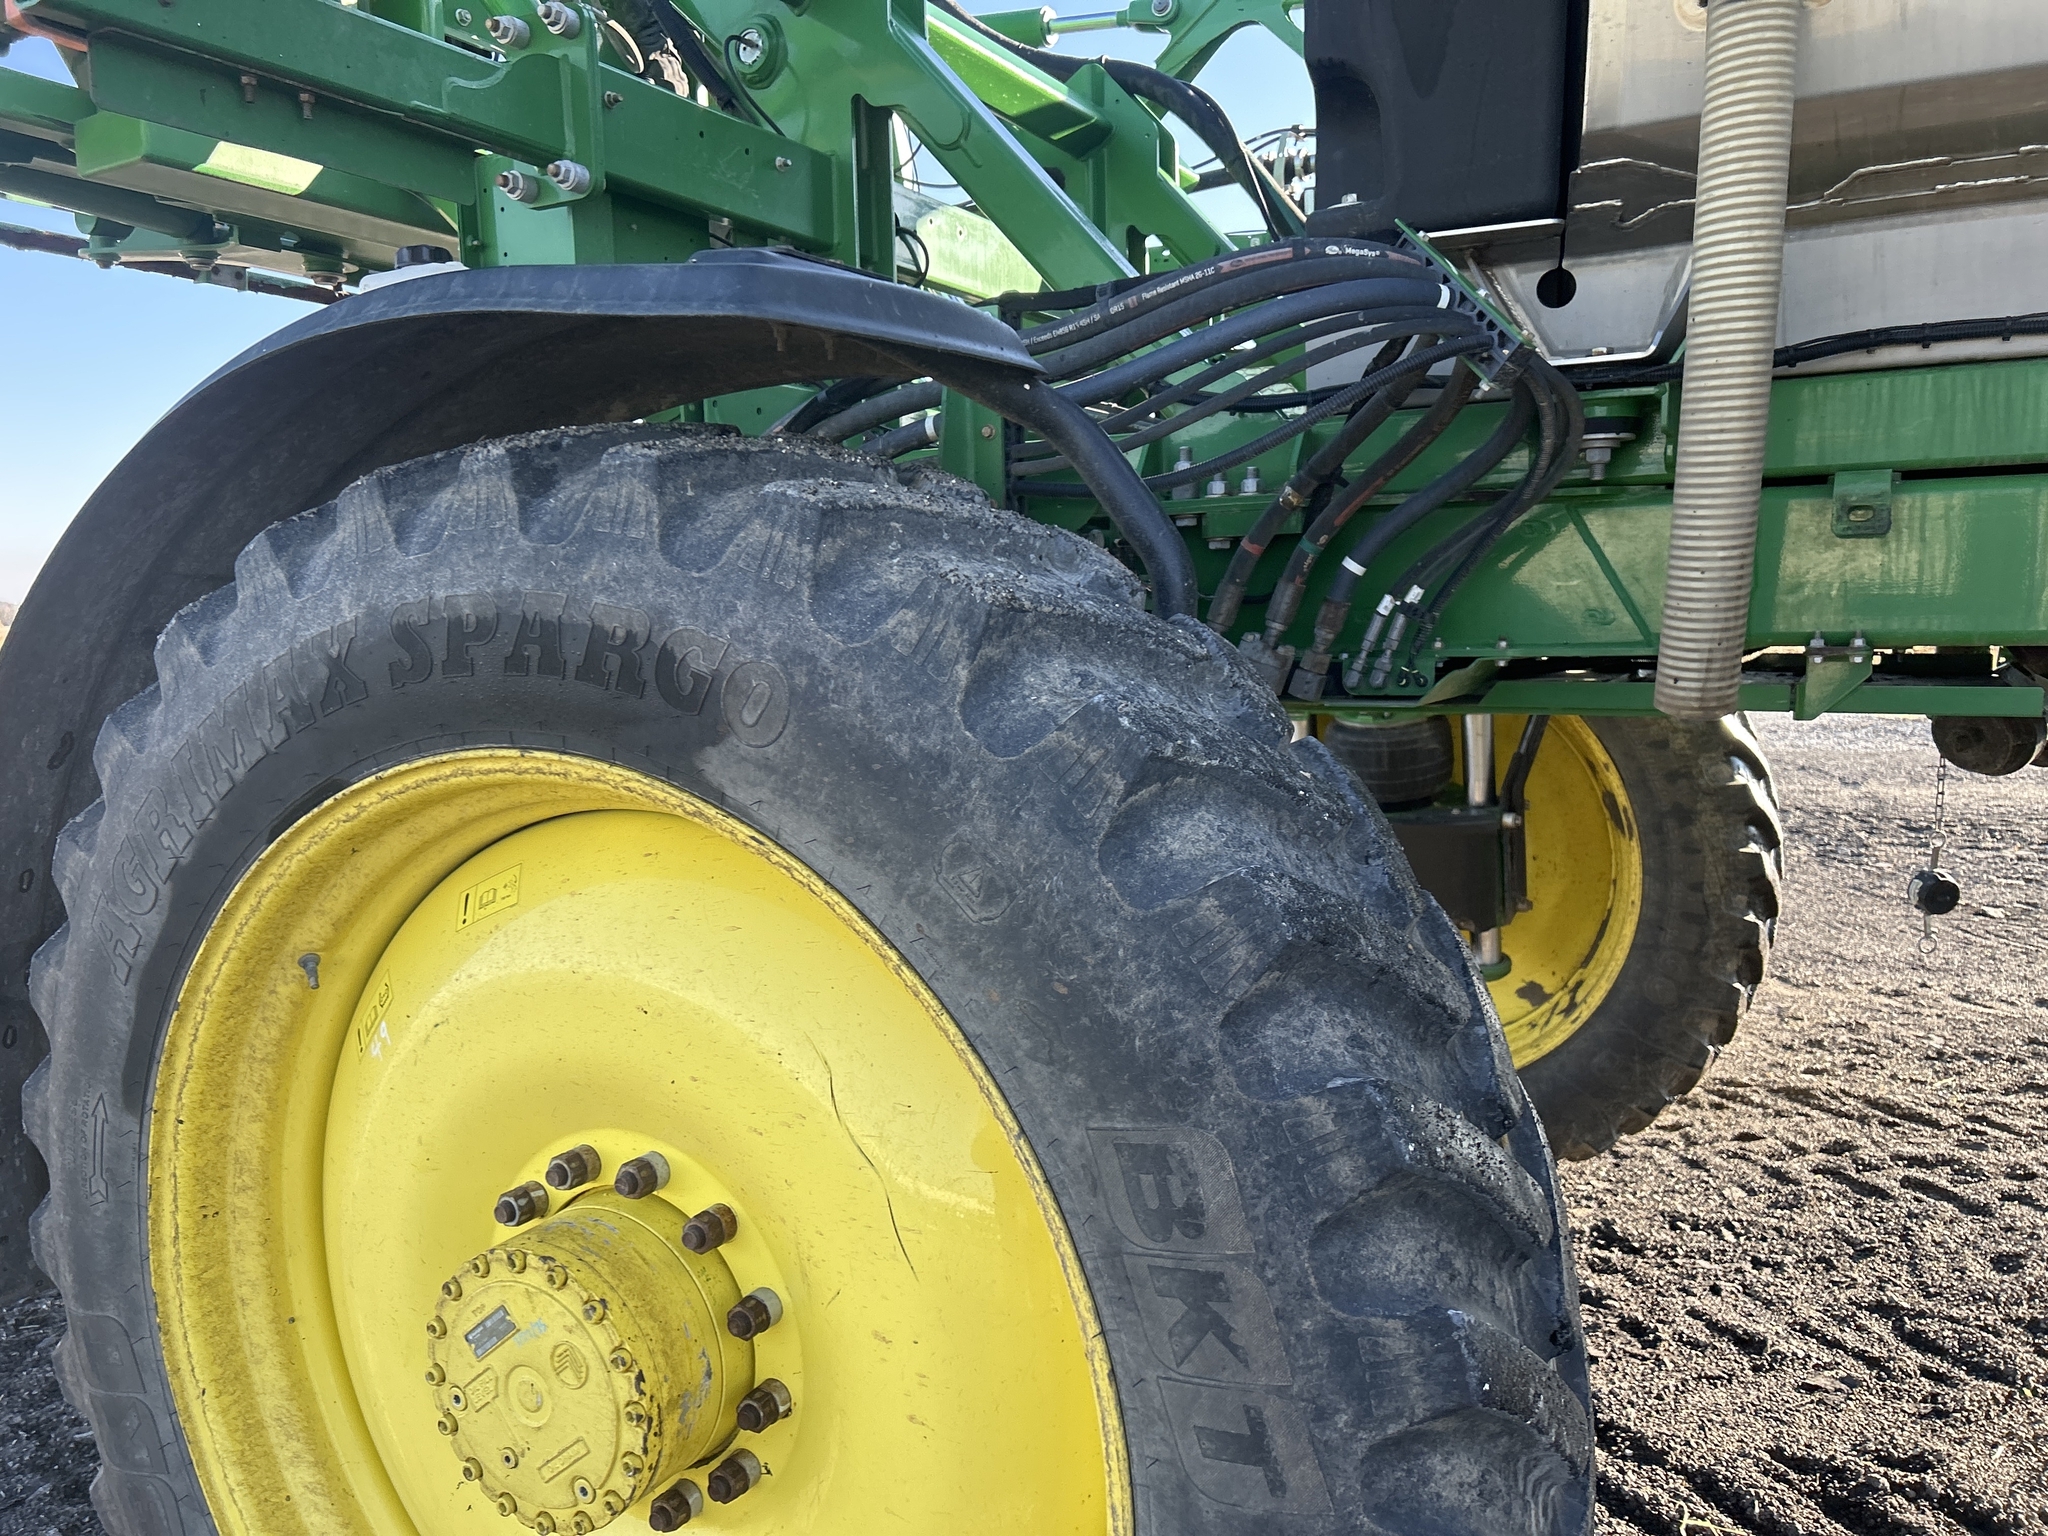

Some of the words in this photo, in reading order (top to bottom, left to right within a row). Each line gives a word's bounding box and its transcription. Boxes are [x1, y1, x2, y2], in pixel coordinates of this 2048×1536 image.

[1141, 289, 1157, 300] Flame
[1156, 280, 1180, 293] Resistant
[1179, 275, 1195, 285] MSHA
[91, 617, 369, 986] AGRIMAX
[388, 589, 790, 748] SPARGO
[1113, 1140, 1287, 1499] BKT
